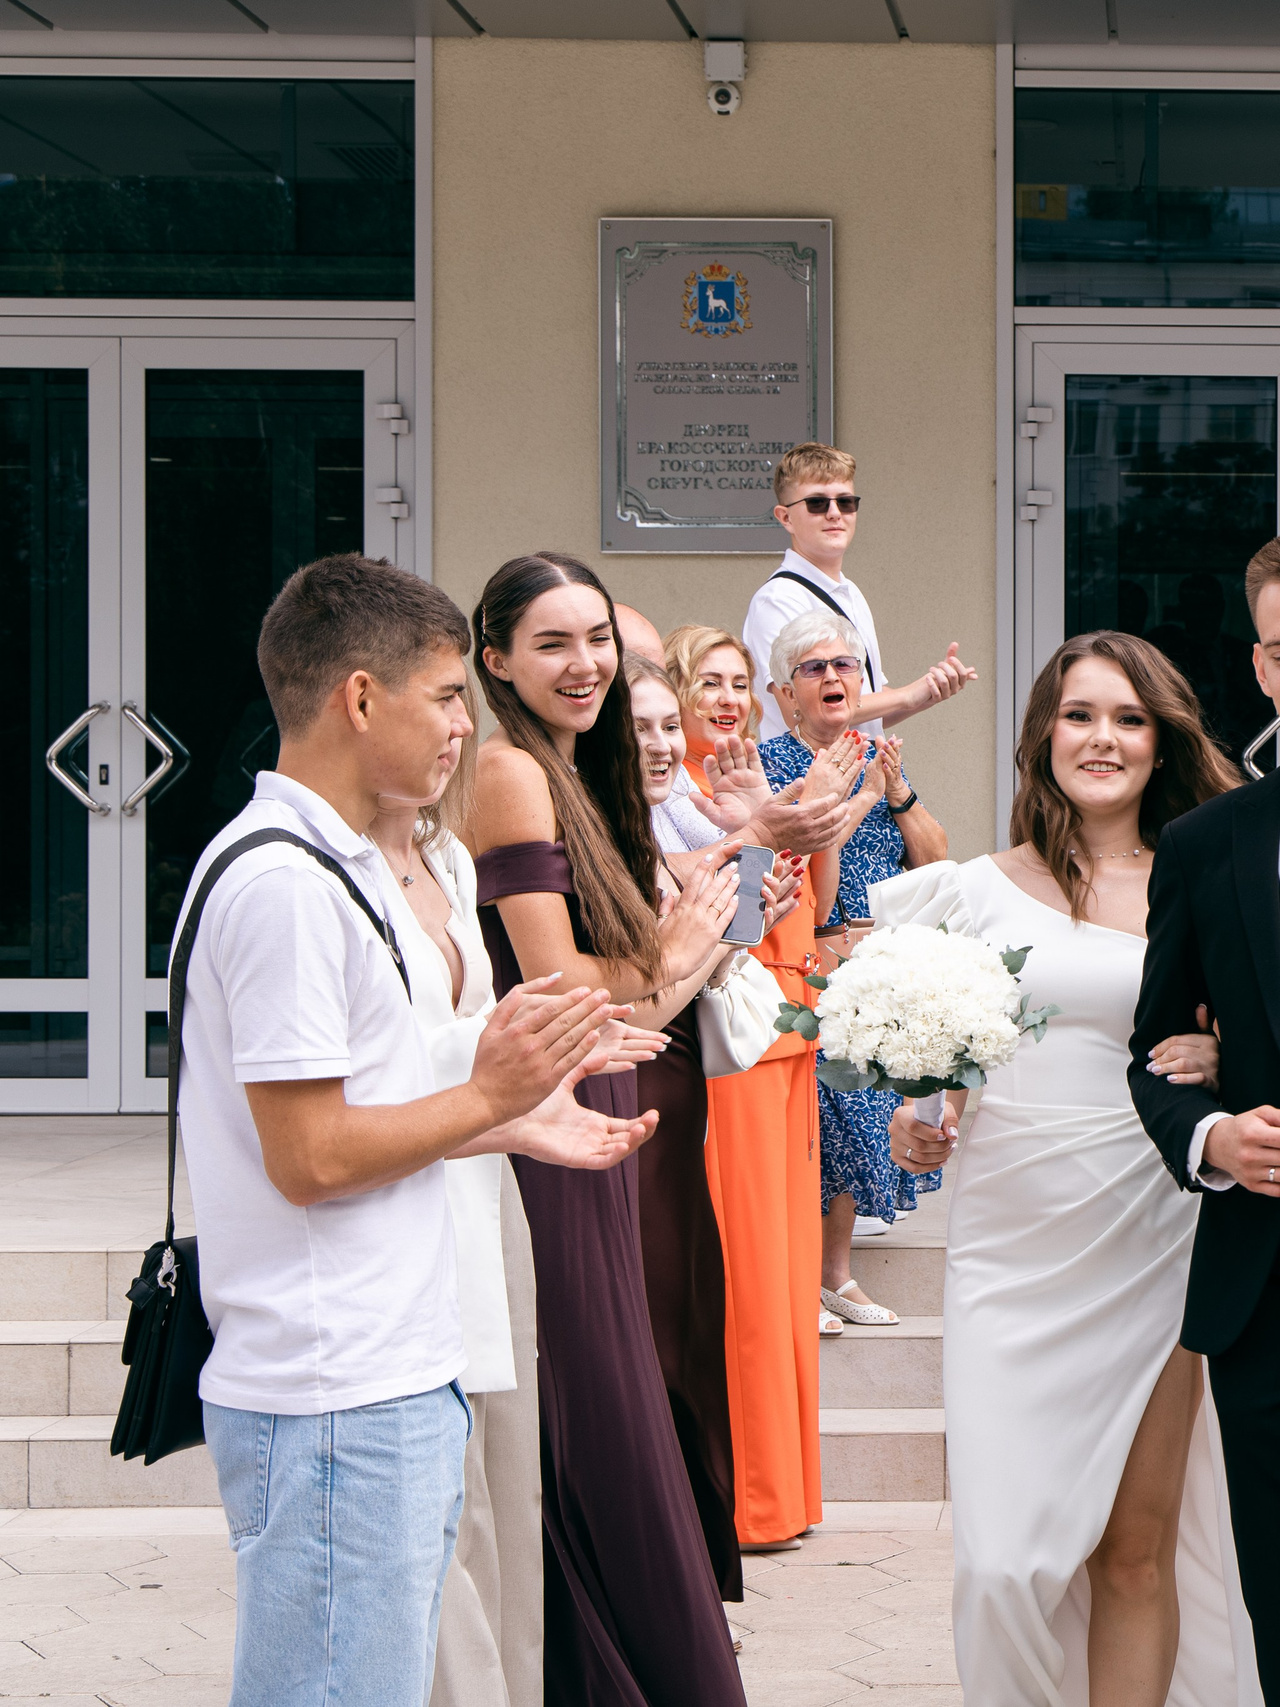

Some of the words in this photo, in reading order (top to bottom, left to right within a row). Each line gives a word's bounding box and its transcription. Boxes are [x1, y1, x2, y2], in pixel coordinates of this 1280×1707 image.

[683, 424, 750, 438] ДВОРЕЦ
[637, 442, 795, 454] БРАКОСОЧЕТАНИЯ
[660, 459, 772, 474] ГОРОДСКОГО
[647, 477, 713, 490] ОКРУГА
[717, 477, 774, 490] САМАР
